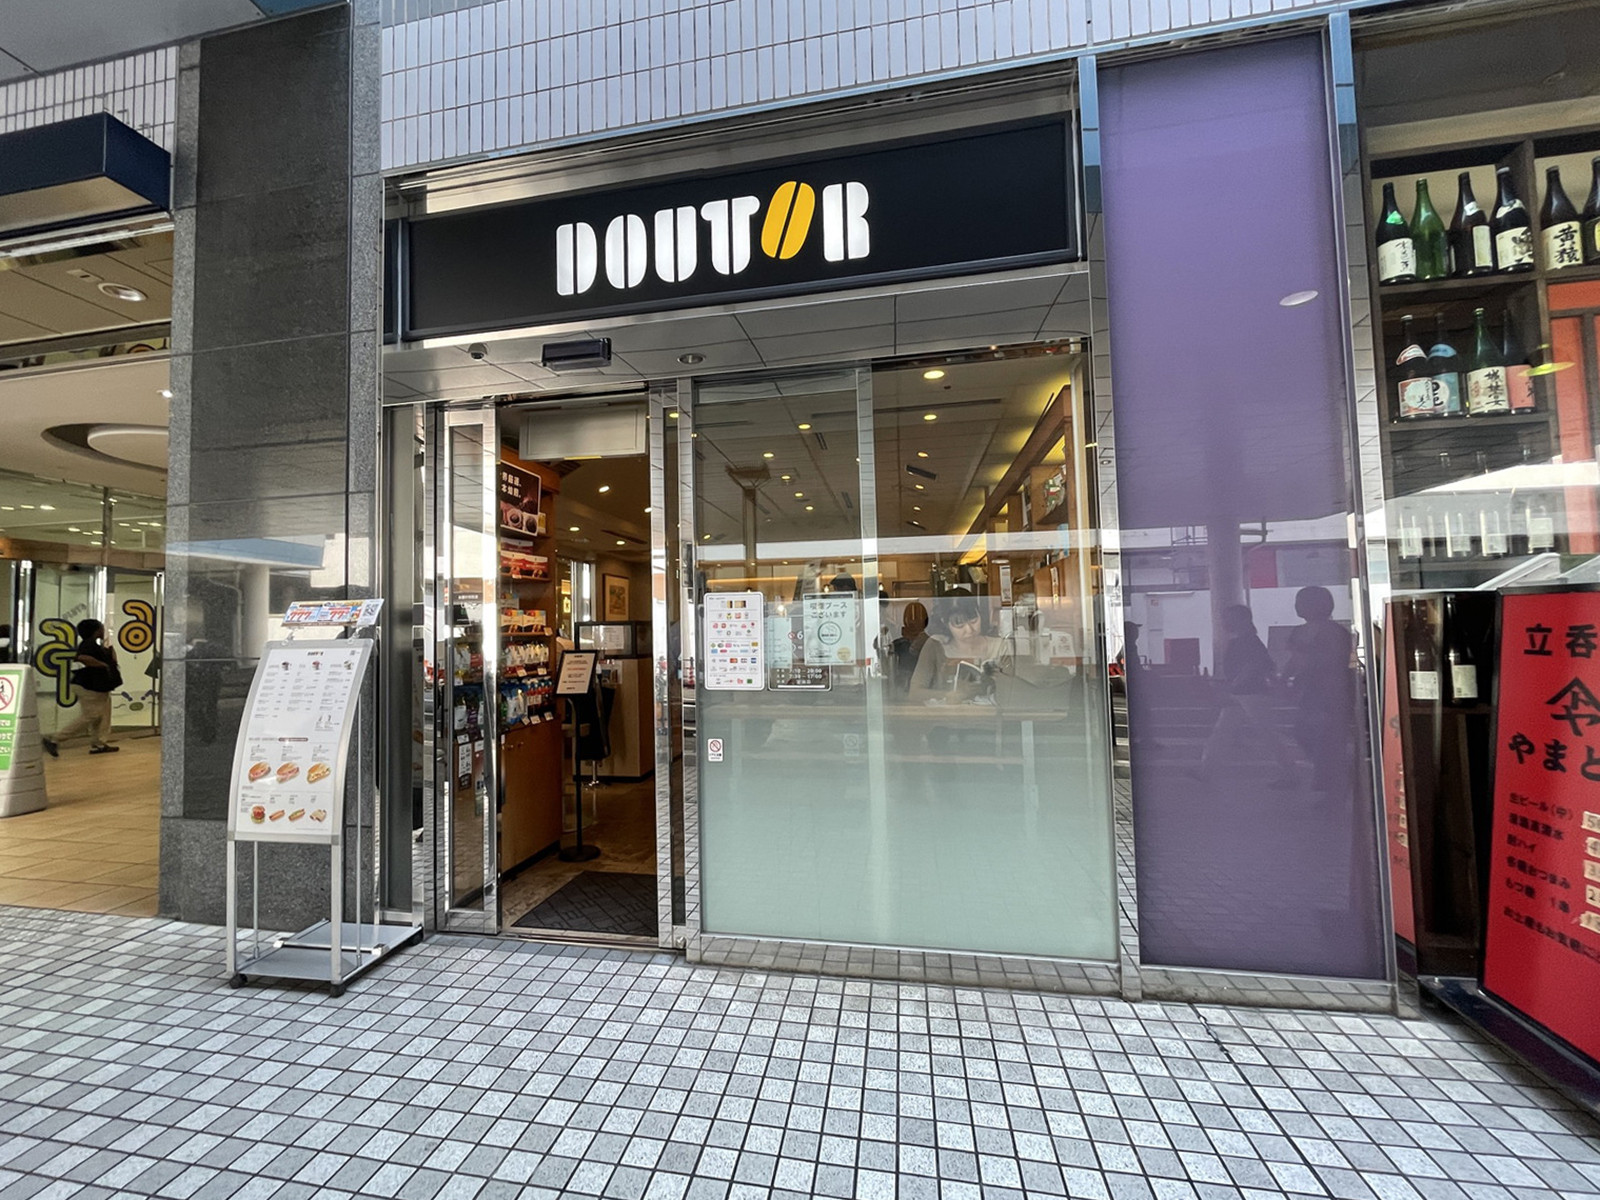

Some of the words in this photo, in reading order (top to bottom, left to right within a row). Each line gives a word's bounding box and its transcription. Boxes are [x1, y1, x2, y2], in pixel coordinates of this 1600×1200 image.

[556, 181, 870, 296] DOUTOR
[1524, 623, 1598, 658] 立呑
[1508, 732, 1600, 782] やまと
